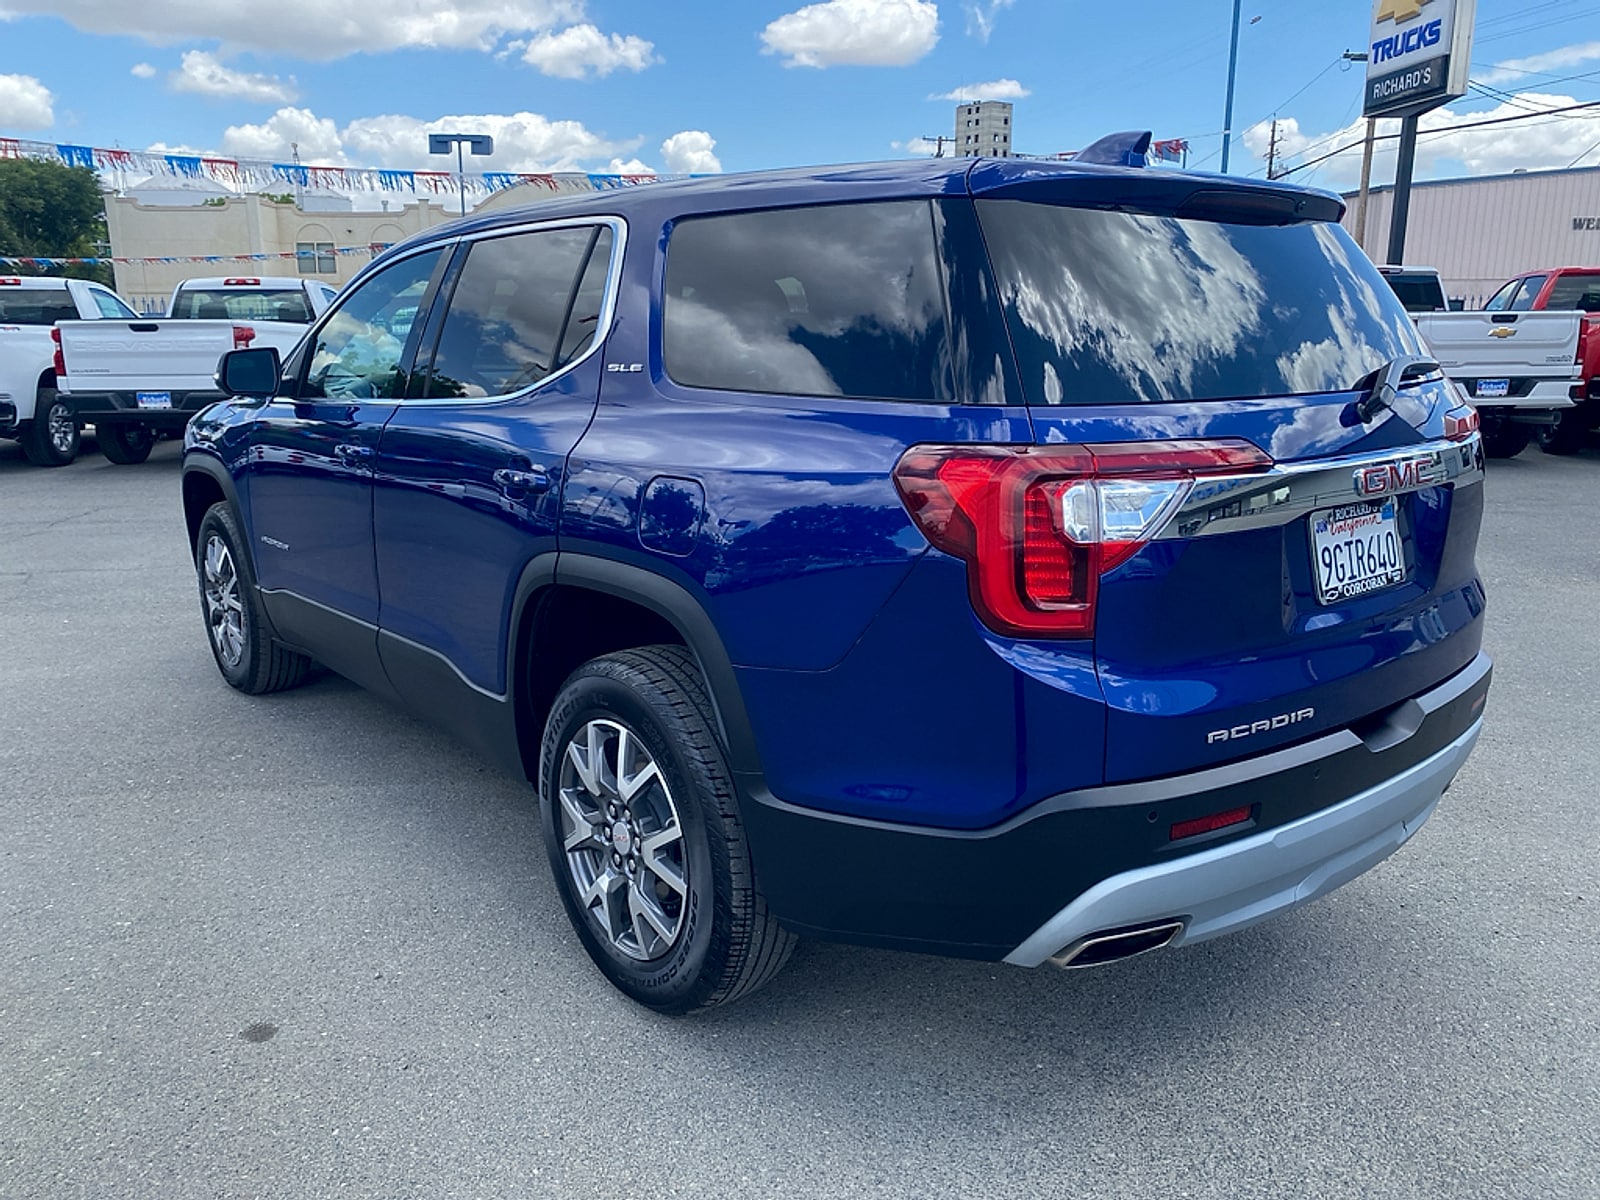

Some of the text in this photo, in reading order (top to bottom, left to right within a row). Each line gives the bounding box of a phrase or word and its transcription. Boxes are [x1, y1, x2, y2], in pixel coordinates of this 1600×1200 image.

[1372, 19, 1442, 64] TRUCKS
[1373, 67, 1432, 99] RICHARD'S
[1361, 458, 1435, 495] GMC
[1321, 531, 1397, 588] 9GIR640
[1207, 707, 1315, 744] ACADIA
